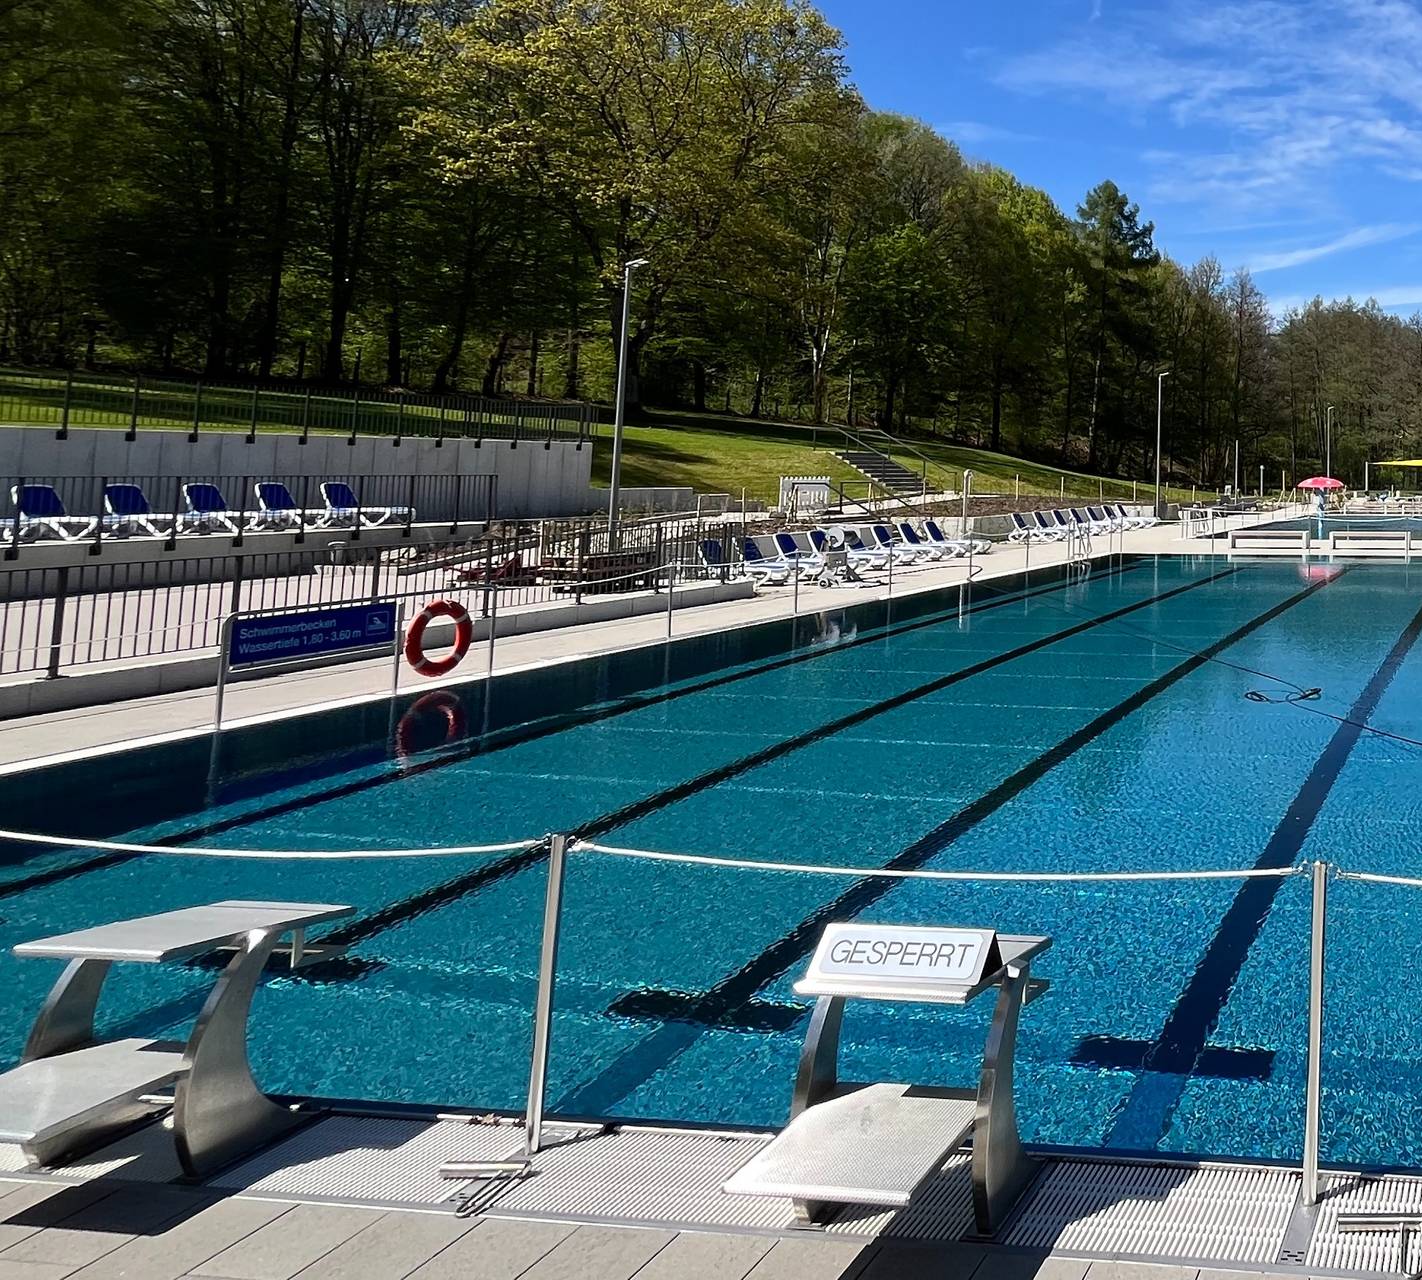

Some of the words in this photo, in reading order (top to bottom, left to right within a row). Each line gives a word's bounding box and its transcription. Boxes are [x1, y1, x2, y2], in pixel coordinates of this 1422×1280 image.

[240, 619, 336, 640] Schwimmerbecken
[239, 636, 300, 654] Wassertiefe
[352, 630, 361, 638] m
[831, 940, 974, 968] GESPERRT
